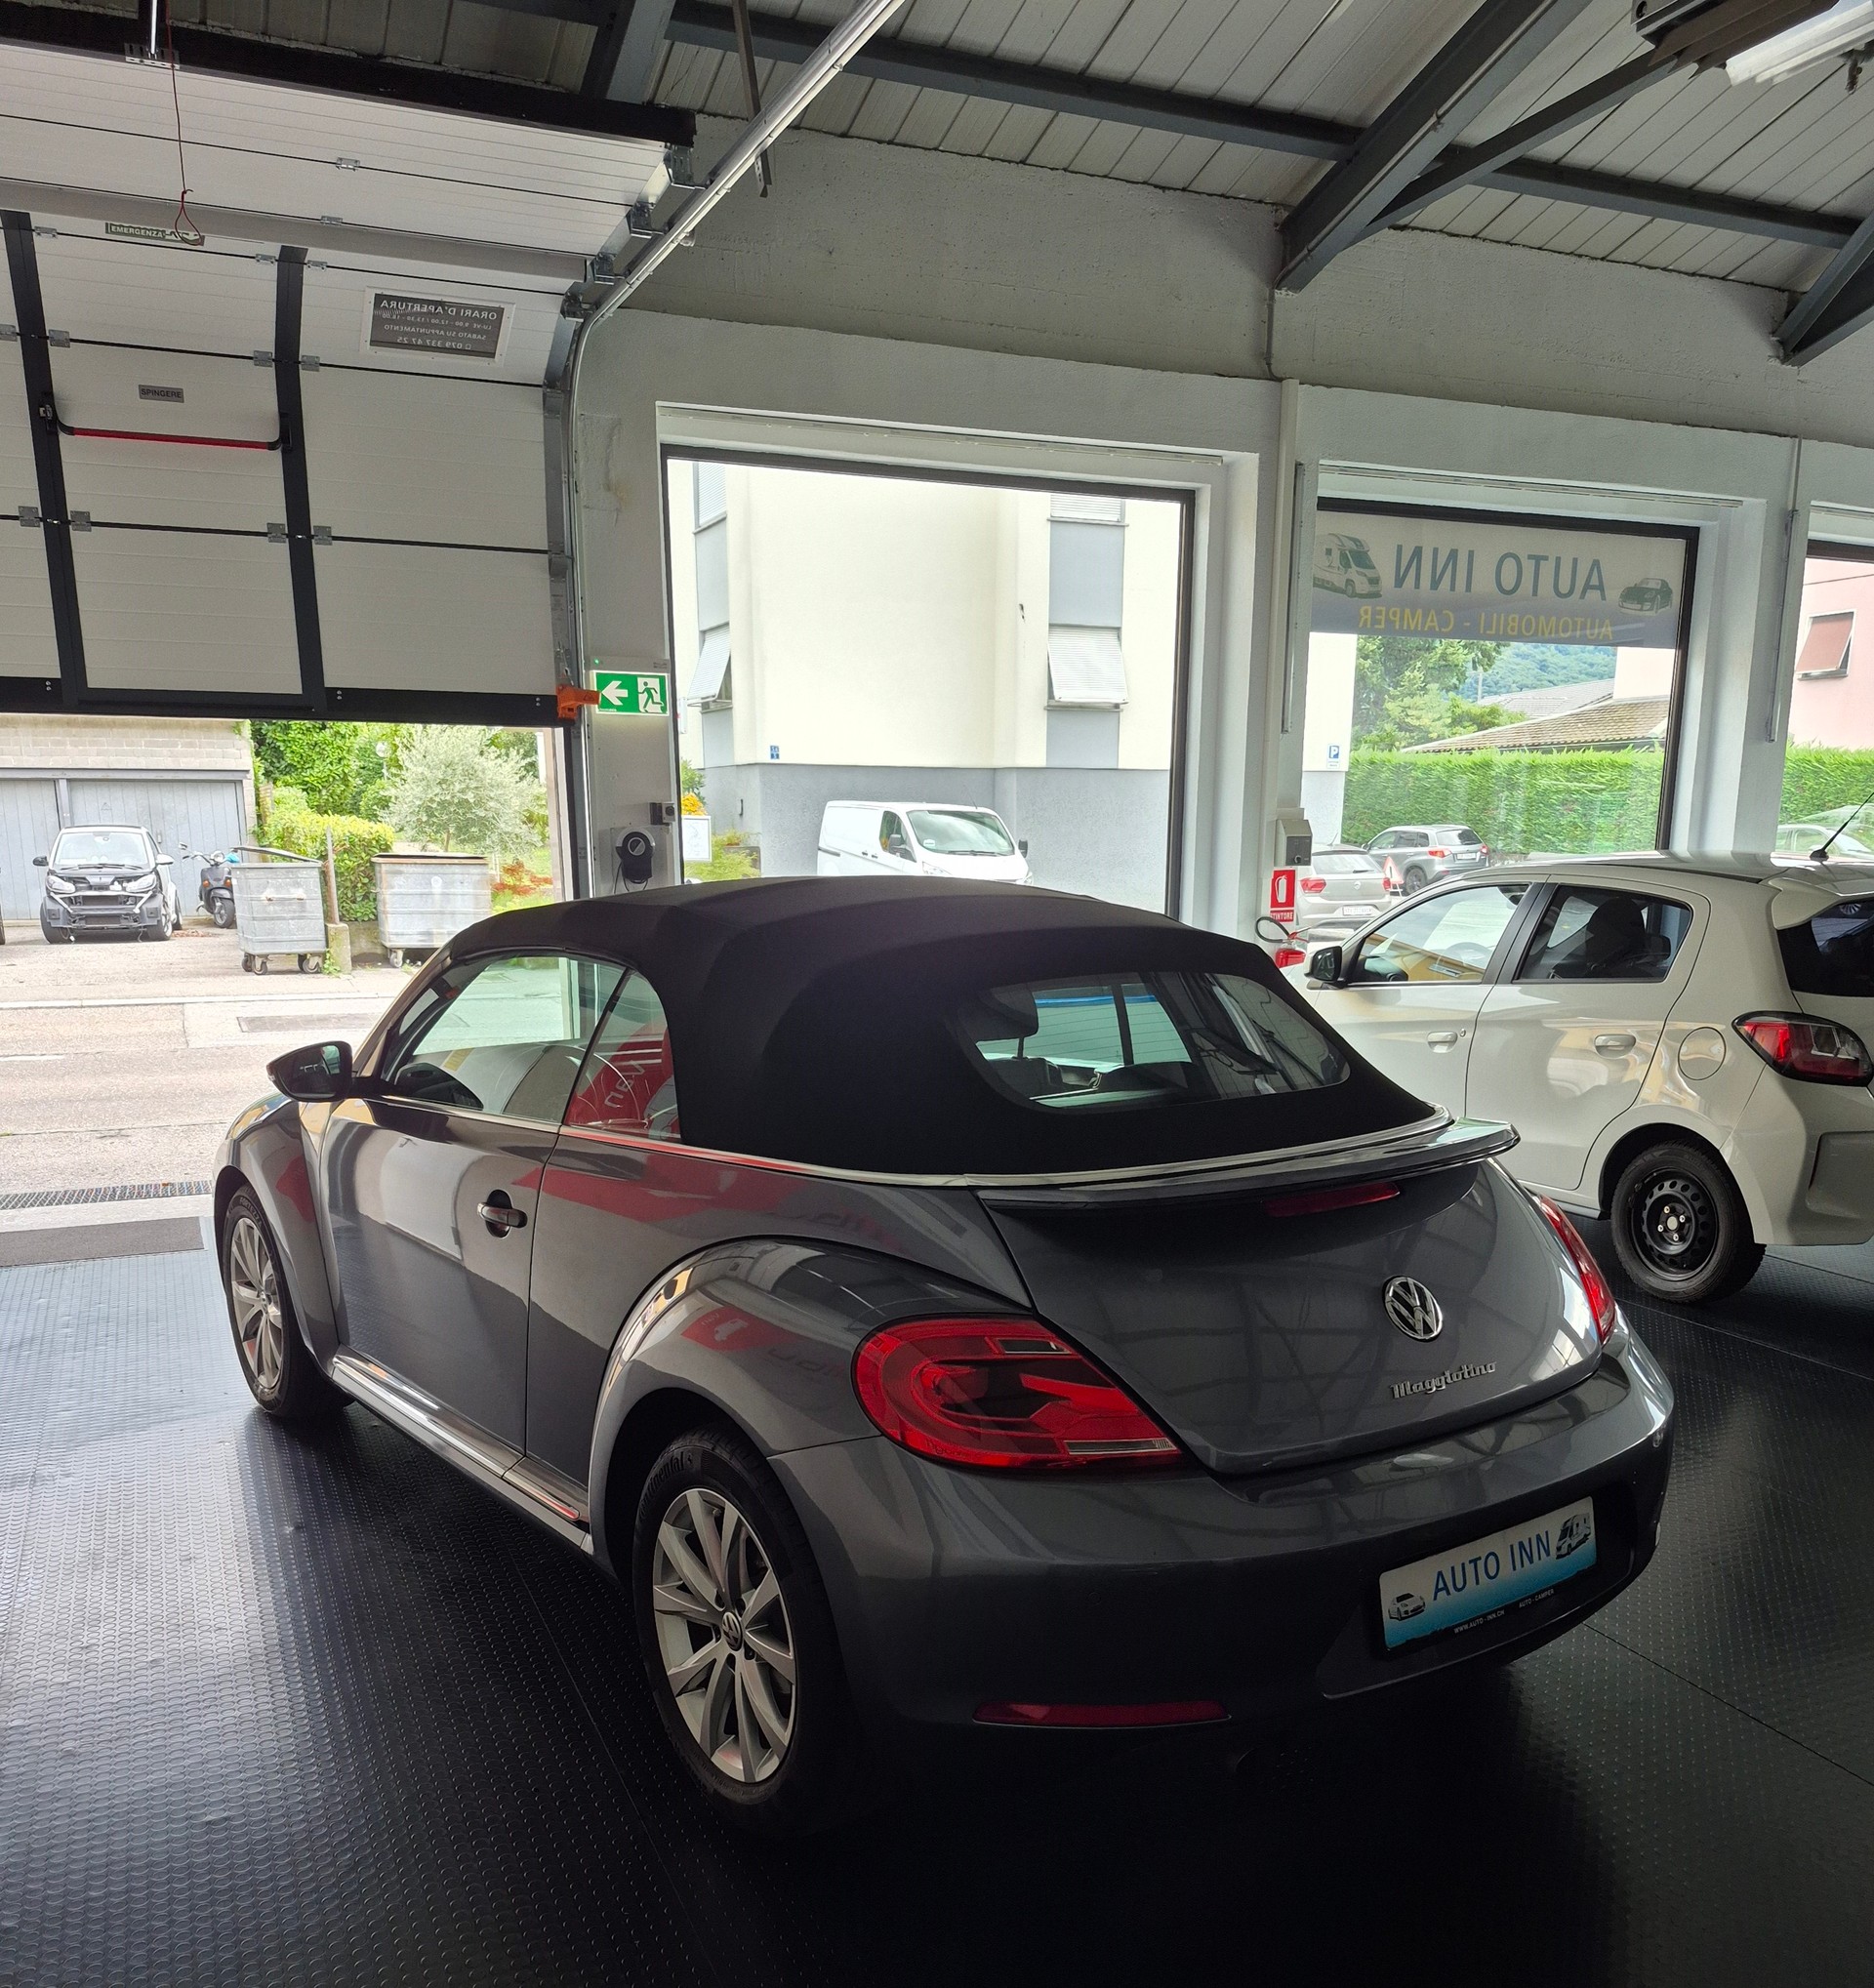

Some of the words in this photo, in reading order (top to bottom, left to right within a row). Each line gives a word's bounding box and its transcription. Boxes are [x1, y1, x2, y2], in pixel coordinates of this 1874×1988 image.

[111, 226, 164, 238] EMERGENZA
[141, 387, 182, 399] SPINGERE
[1433, 1551, 1500, 1602] AUTO
[1509, 1530, 1552, 1571] INN
[1519, 1598, 1532, 1608] AUTO
[1534, 1588, 1555, 1602] CAMPER
